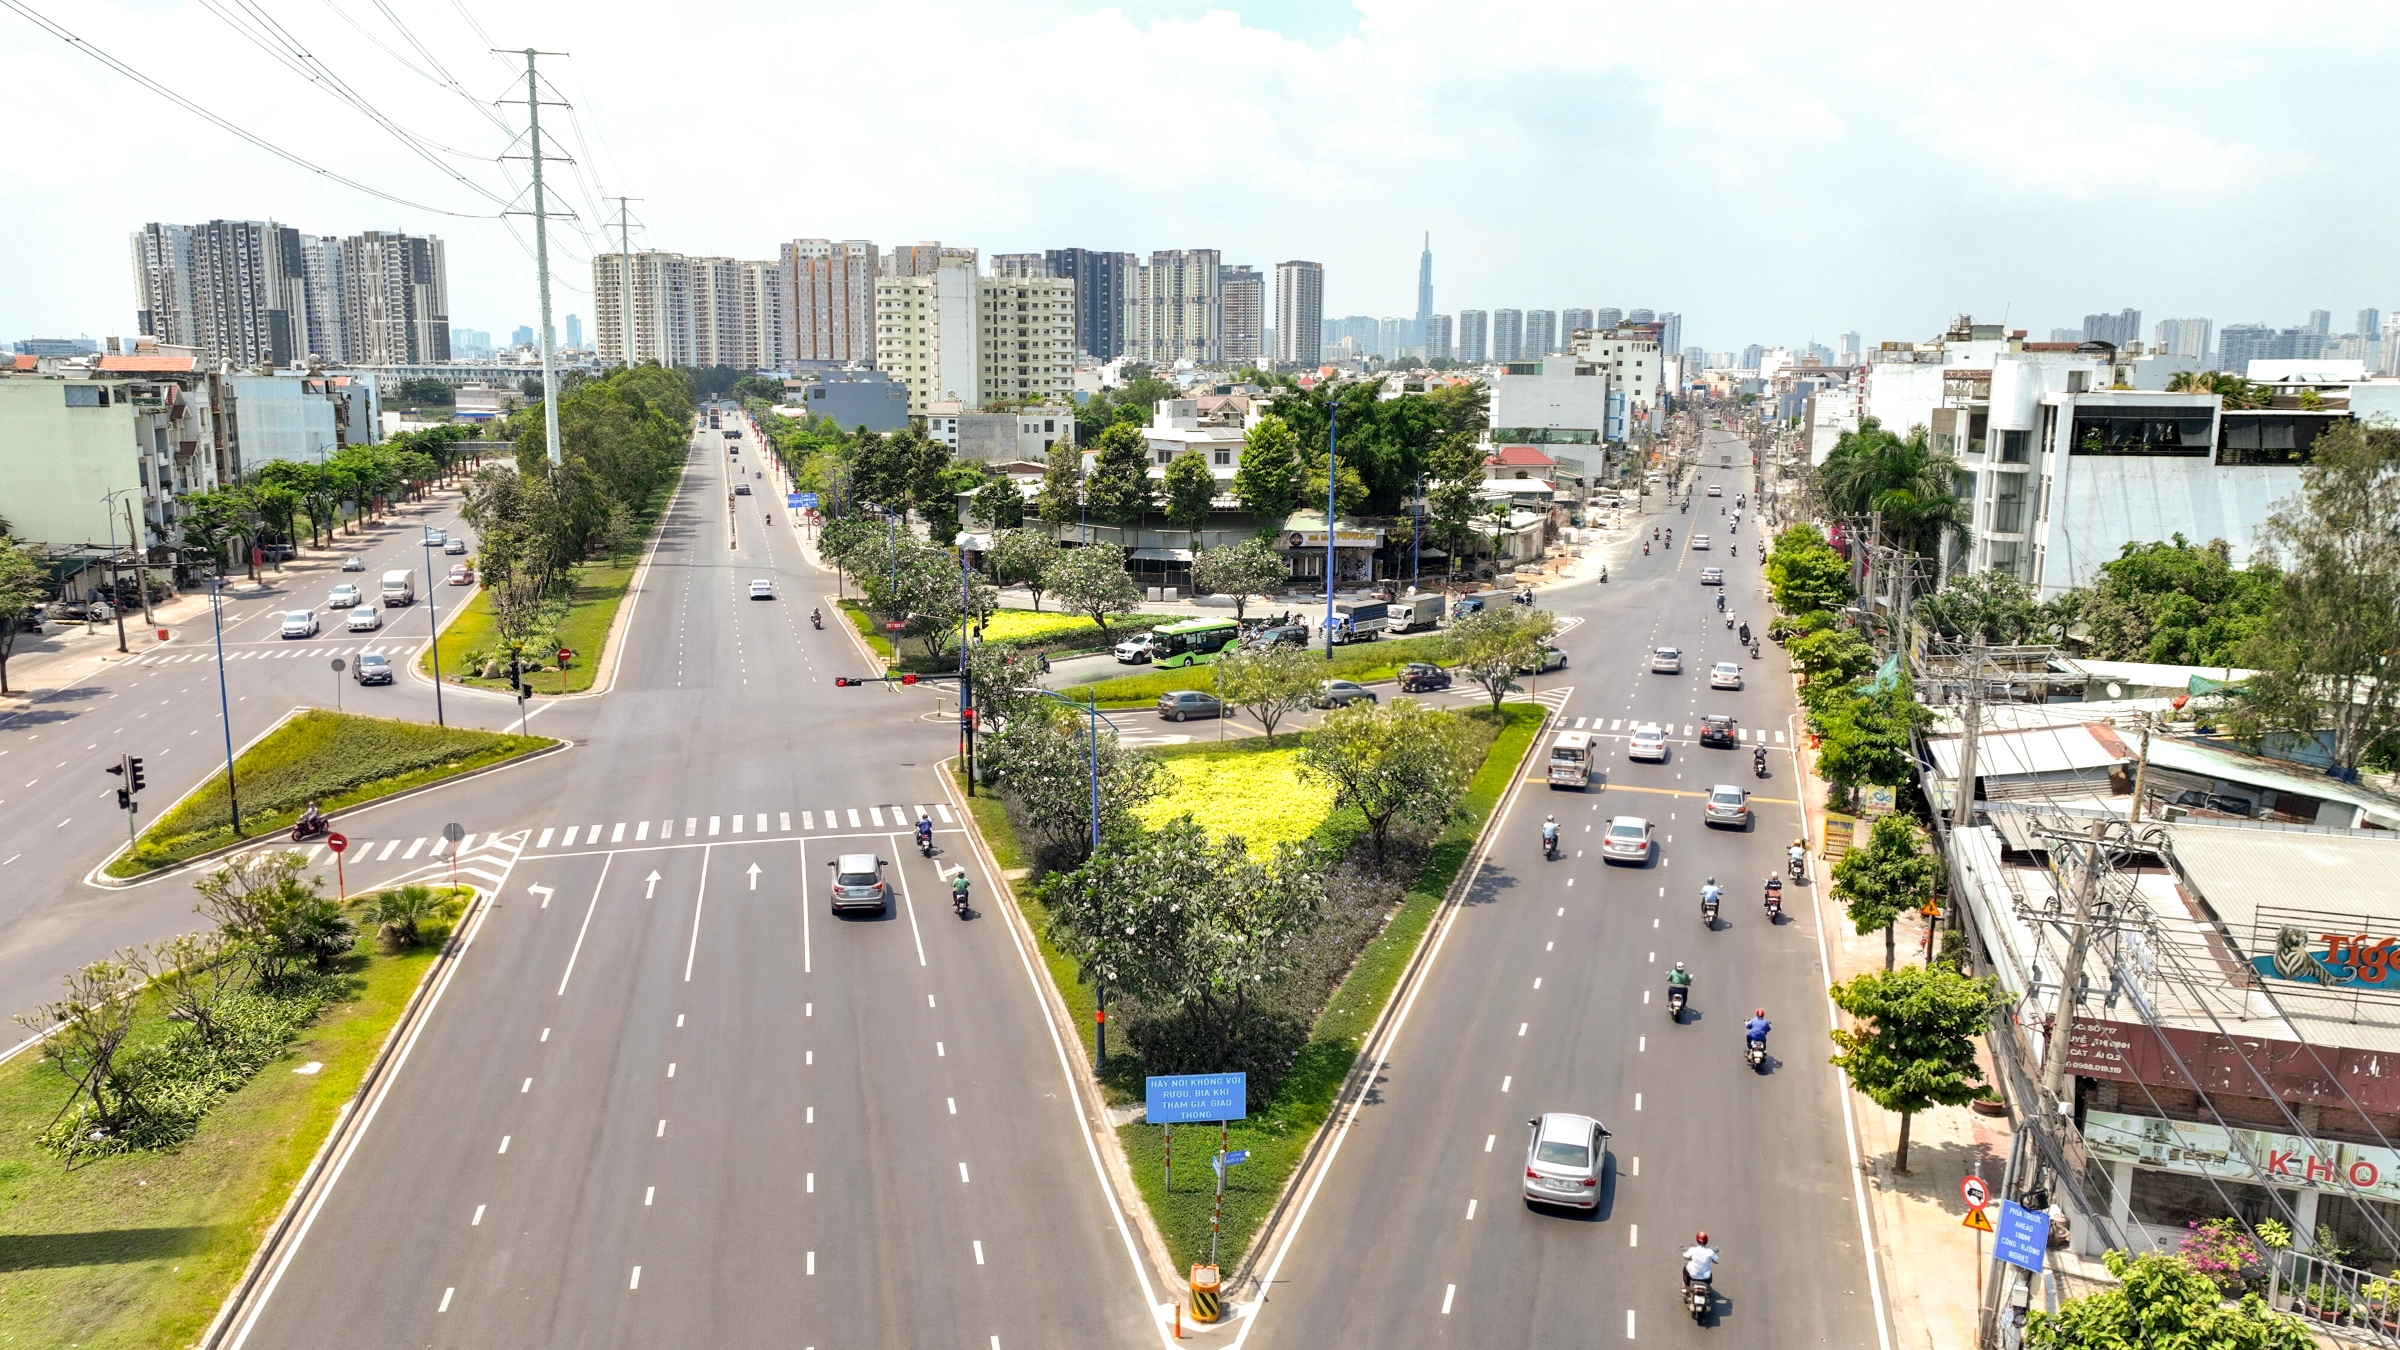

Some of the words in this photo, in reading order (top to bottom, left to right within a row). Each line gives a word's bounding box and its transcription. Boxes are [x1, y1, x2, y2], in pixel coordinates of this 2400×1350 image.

[1857, 366, 1866, 414] HOTEL
[1336, 532, 1376, 541] MIMOSA
[2070, 1048, 2088, 1057] CÁT
[1171, 1078, 1187, 1087] NÓI
[1190, 1077, 1223, 1086] KHÔNG
[1195, 1089, 1210, 1097] BIA
[1213, 1088, 1229, 1096] KHI
[1162, 1101, 1188, 1109] THAM
[1191, 1100, 1206, 1108] GIA
[1210, 1099, 1232, 1107] GIAO
[2267, 1149, 2379, 1188] KHO
[2009, 1206, 2022, 1218] PHÍA
[2014, 1221, 2034, 1233] AHEAD
[2008, 1250, 2029, 1263] WORKS
